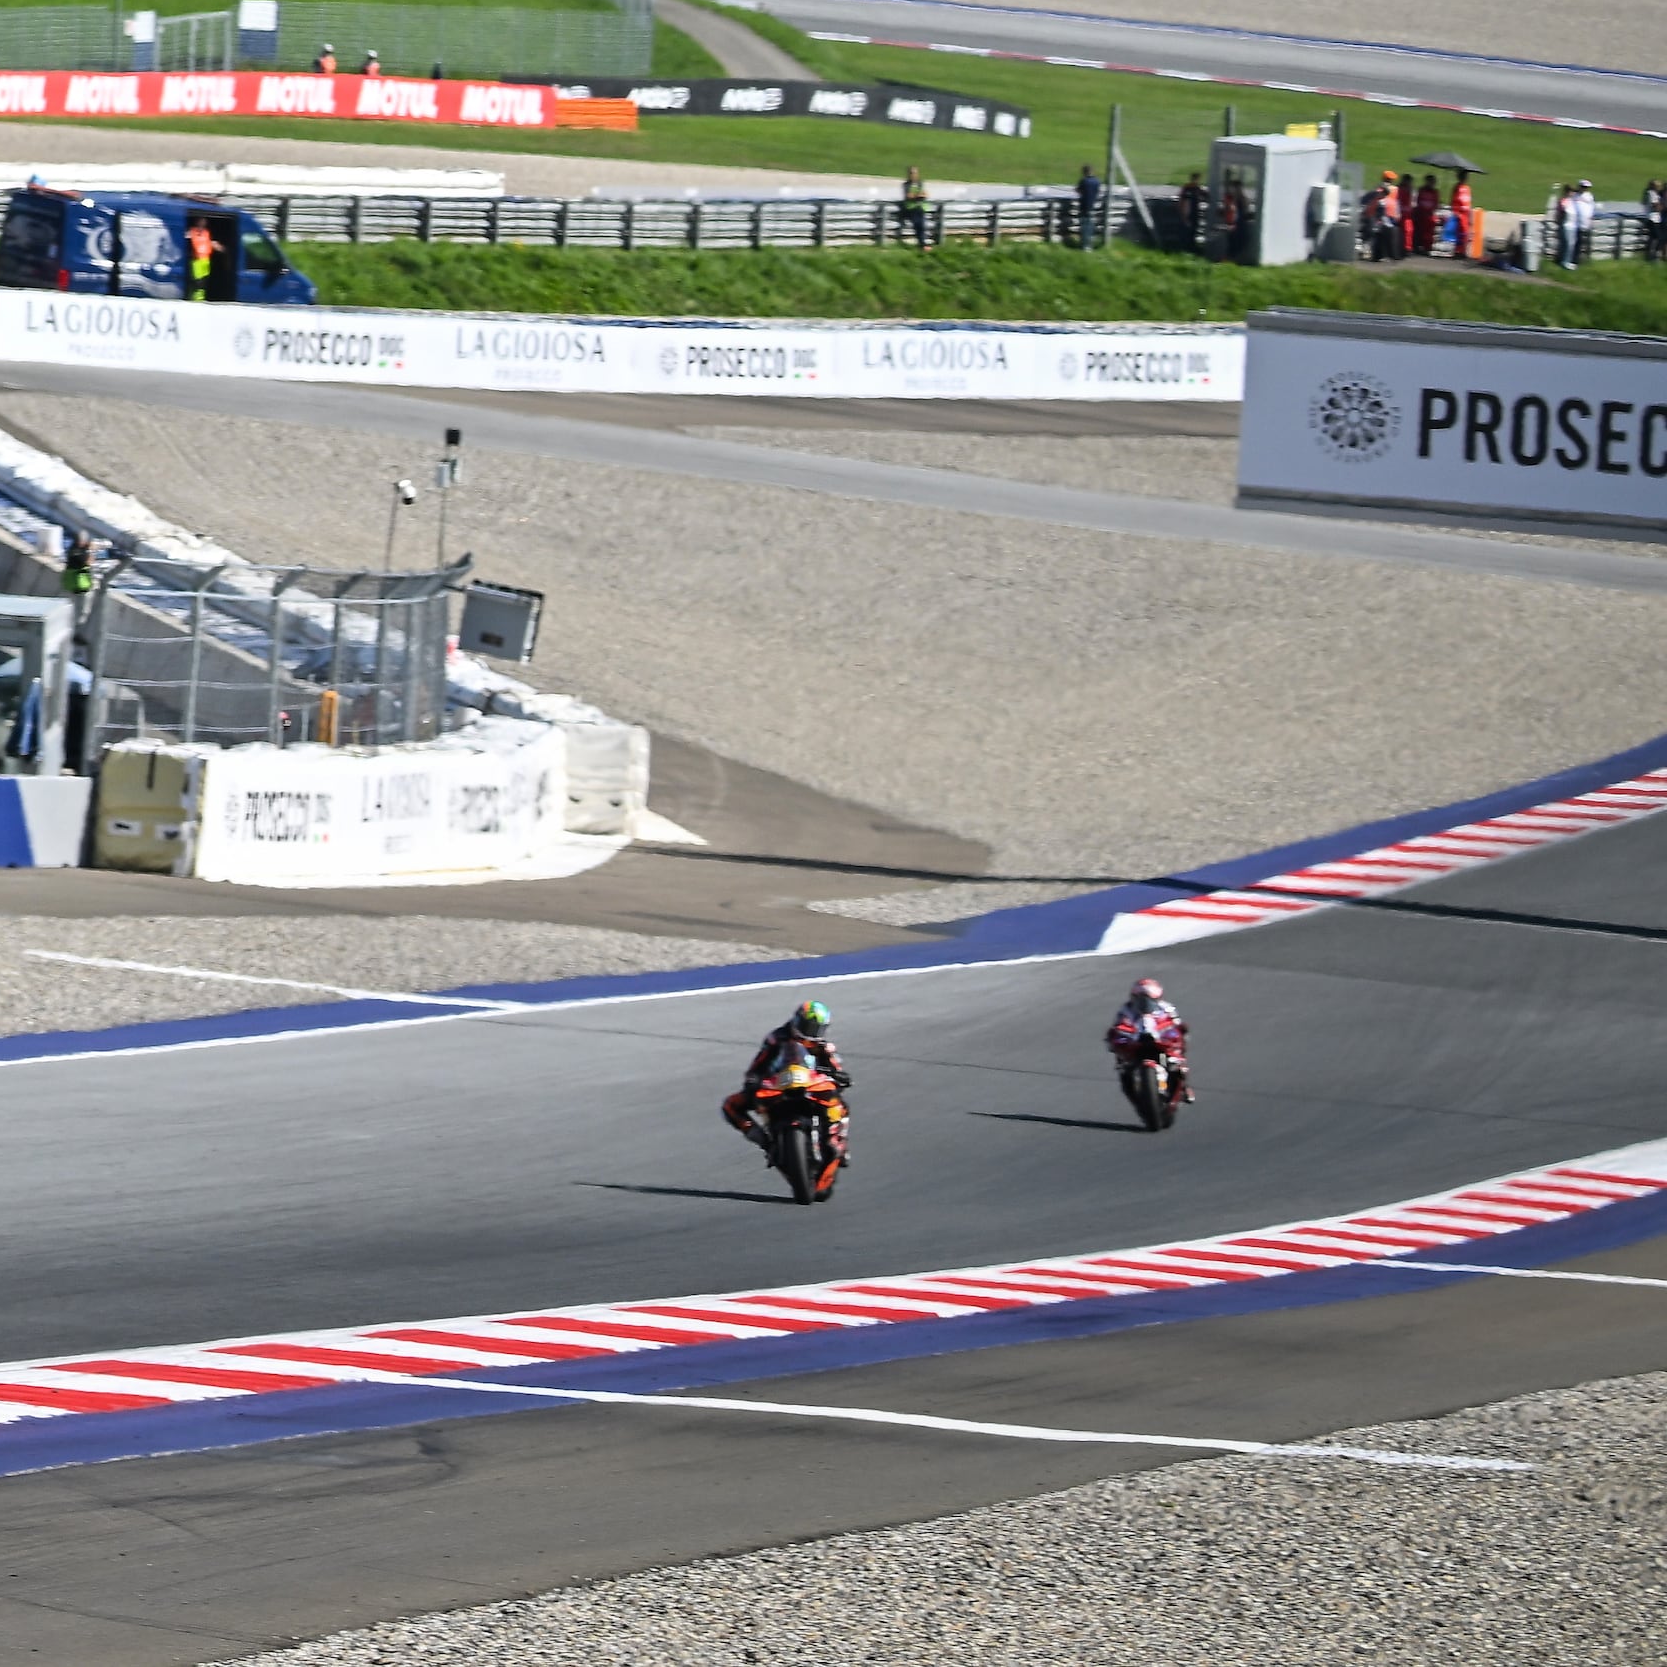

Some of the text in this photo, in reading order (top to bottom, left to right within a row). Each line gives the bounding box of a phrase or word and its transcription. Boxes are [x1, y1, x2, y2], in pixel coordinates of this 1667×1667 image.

[65, 75, 141, 114] MOTUL
[159, 76, 236, 113] MOTUL
[256, 75, 335, 116] MOTUL
[356, 78, 438, 119] MOTUL
[459, 85, 543, 126] MOTUL
[265, 327, 373, 367] PROSECCO
[686, 346, 787, 380] PROSECCO
[1085, 352, 1182, 384] PROSECCO
